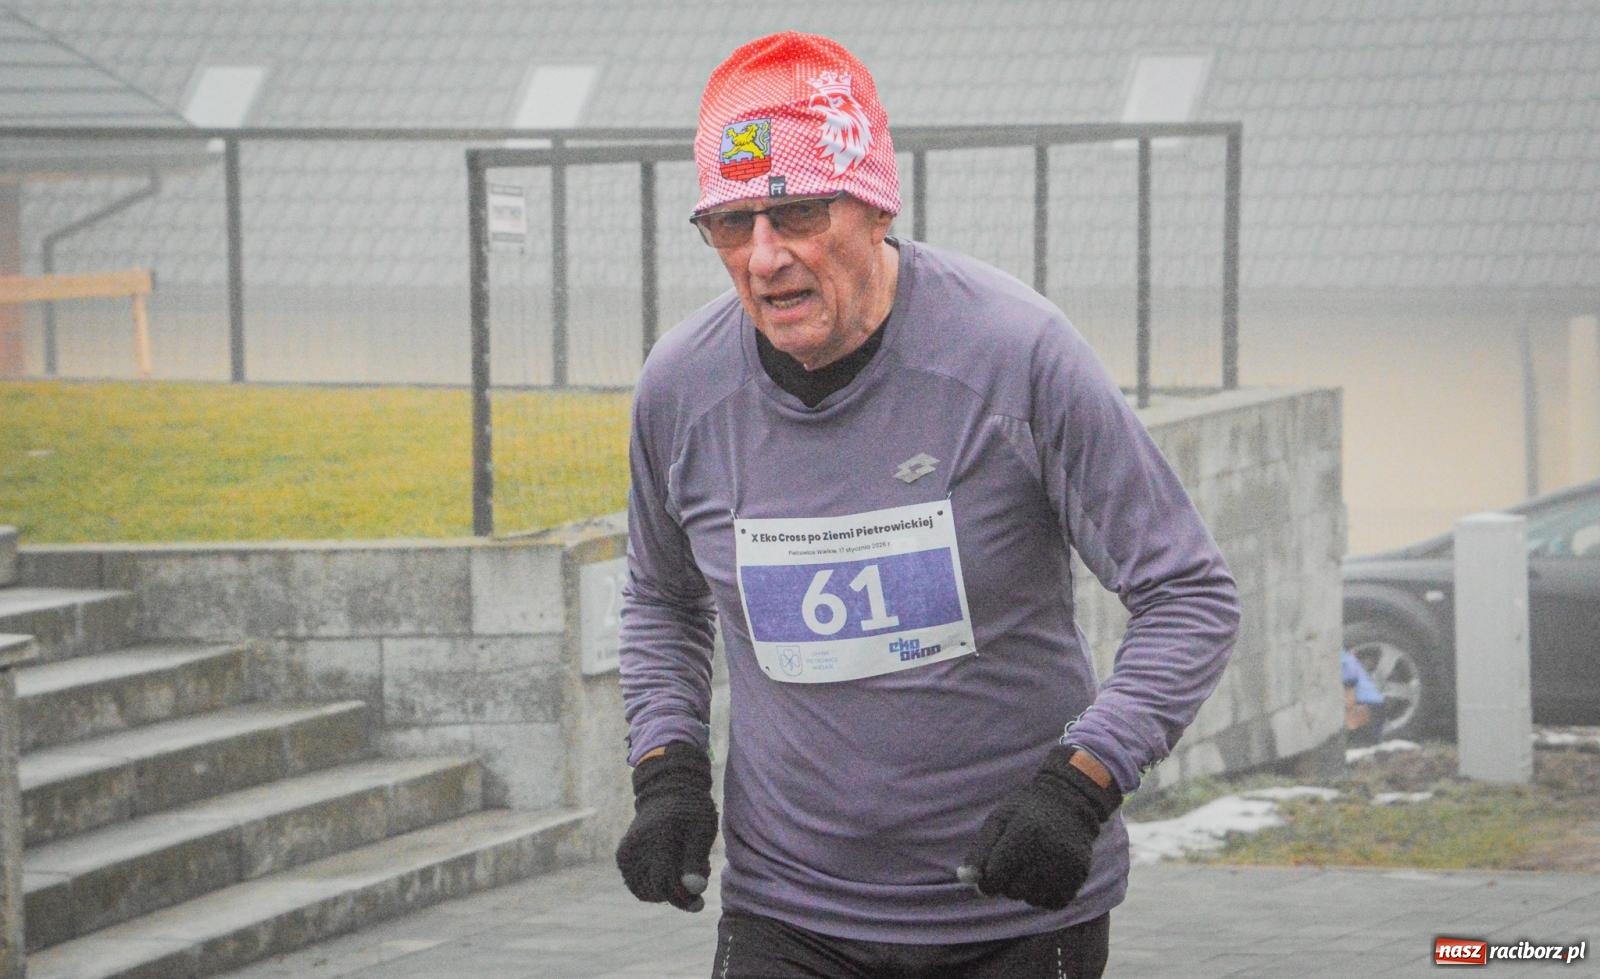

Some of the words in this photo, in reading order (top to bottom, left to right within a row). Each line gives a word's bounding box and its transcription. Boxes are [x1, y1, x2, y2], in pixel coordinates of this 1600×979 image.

[751, 533, 759, 543] X
[760, 533, 778, 543] Eko
[778, 533, 806, 542] Cross
[808, 533, 821, 544] po
[822, 528, 855, 541] Ziemi
[856, 516, 934, 538] Pietrowickiej
[801, 564, 900, 636] 61
[900, 644, 942, 662] okno
